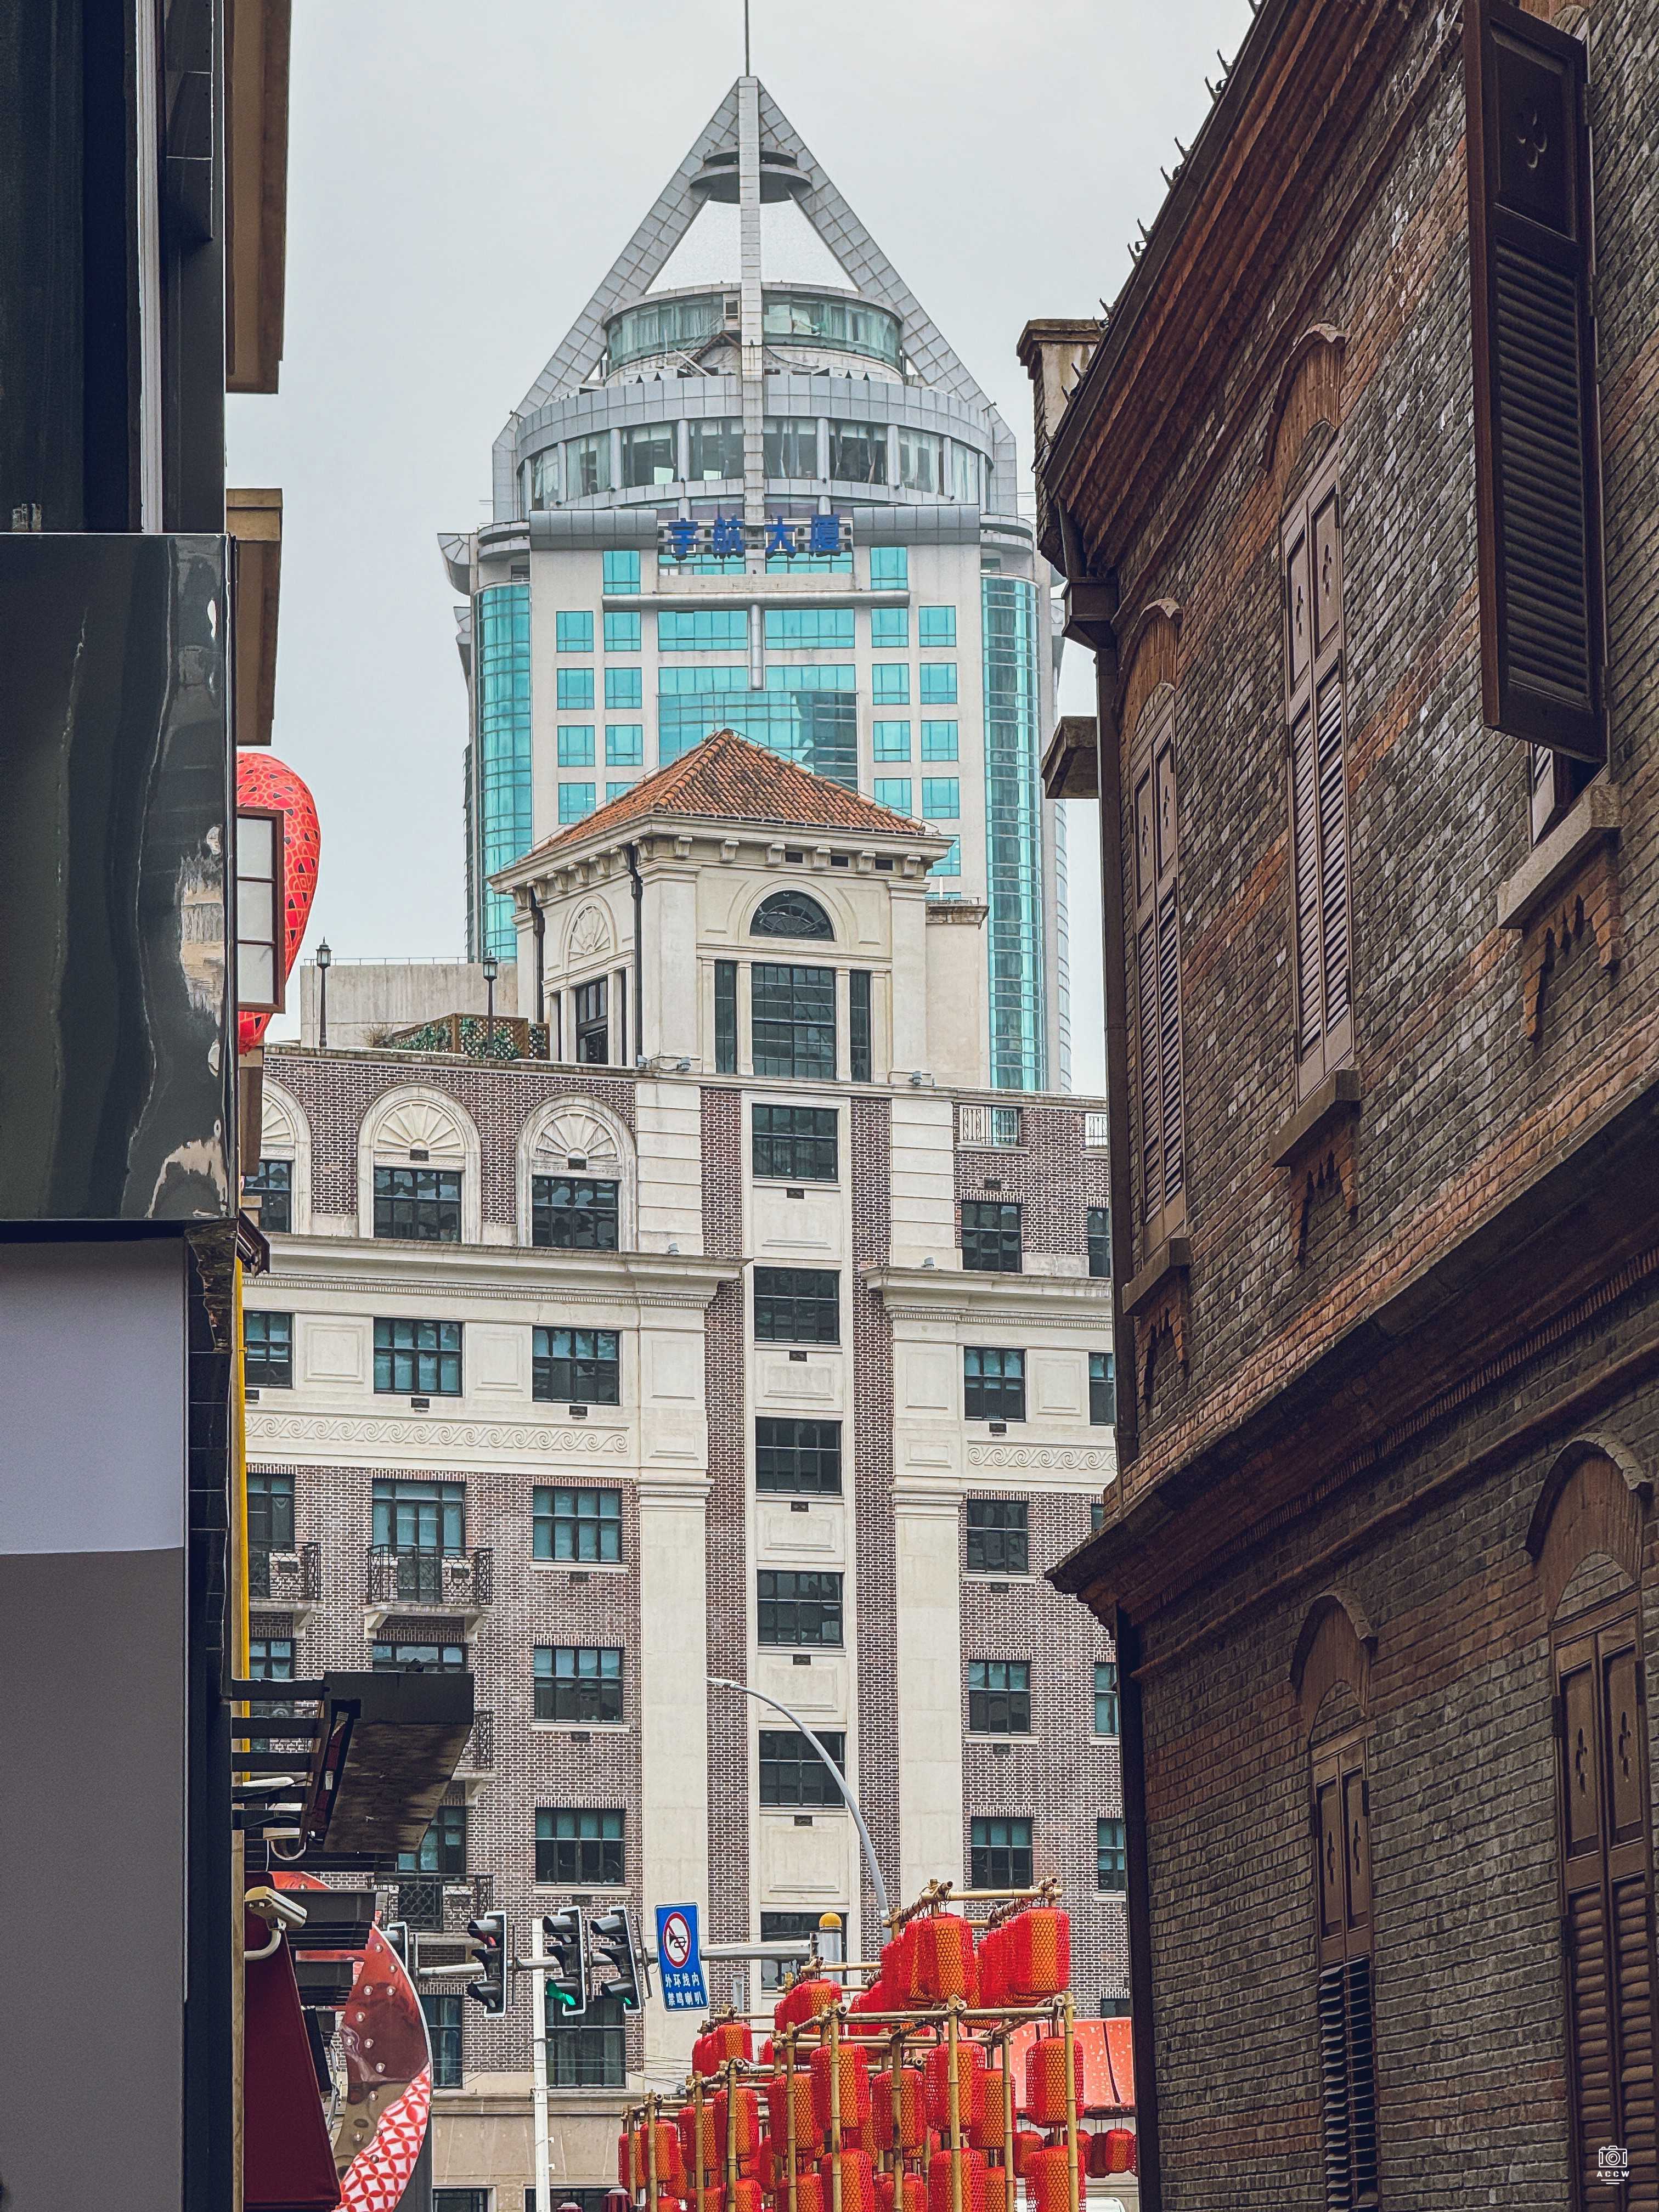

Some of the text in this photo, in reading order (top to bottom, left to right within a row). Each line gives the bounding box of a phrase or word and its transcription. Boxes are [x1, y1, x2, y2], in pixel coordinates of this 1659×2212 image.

[667, 514, 840, 560] 宇航大厦
[665, 1972, 700, 1988] 外环线内
[668, 1991, 704, 2006] 禁鸣喇叭
